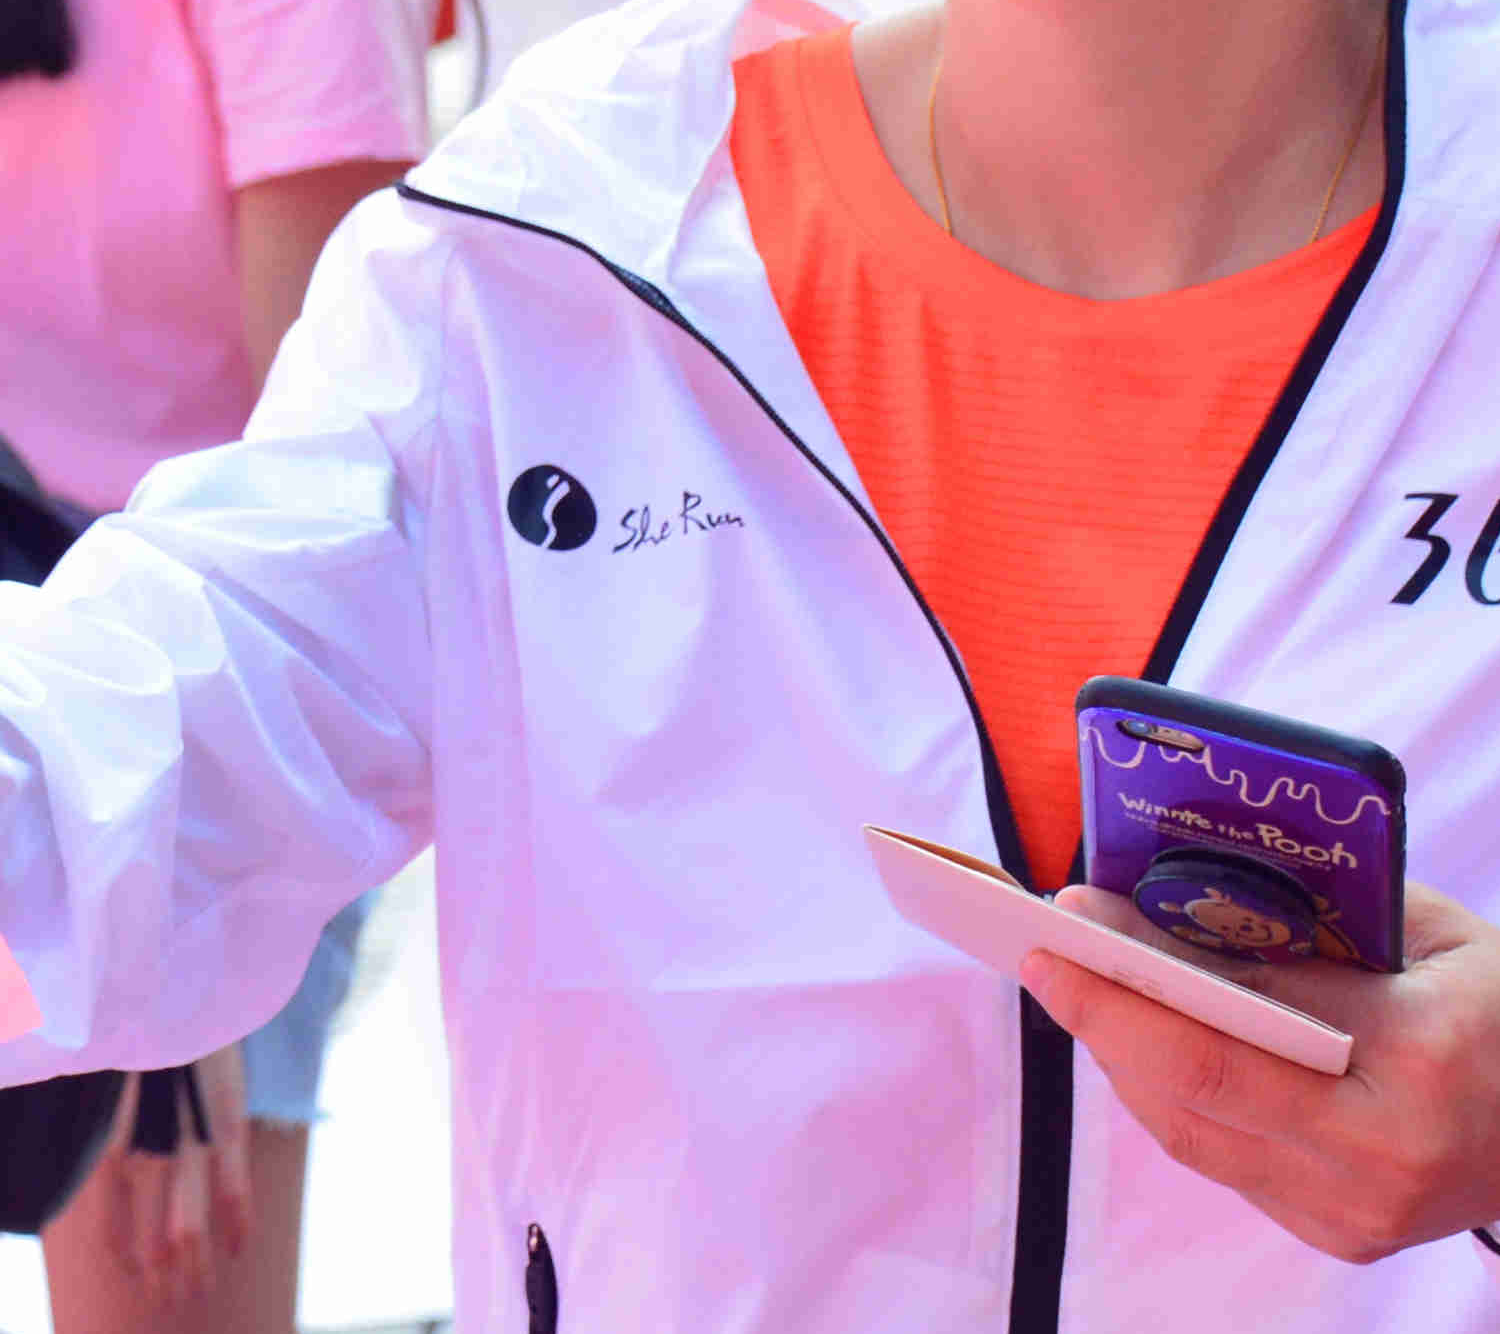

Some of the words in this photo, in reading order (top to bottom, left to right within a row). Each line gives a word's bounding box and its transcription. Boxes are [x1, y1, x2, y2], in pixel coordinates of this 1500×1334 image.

[612, 505, 672, 554] She
[680, 490, 745, 536] Run
[1117, 792, 1213, 831] Winnie
[1216, 823, 1255, 841] the
[1255, 822, 1359, 870] Pooh
